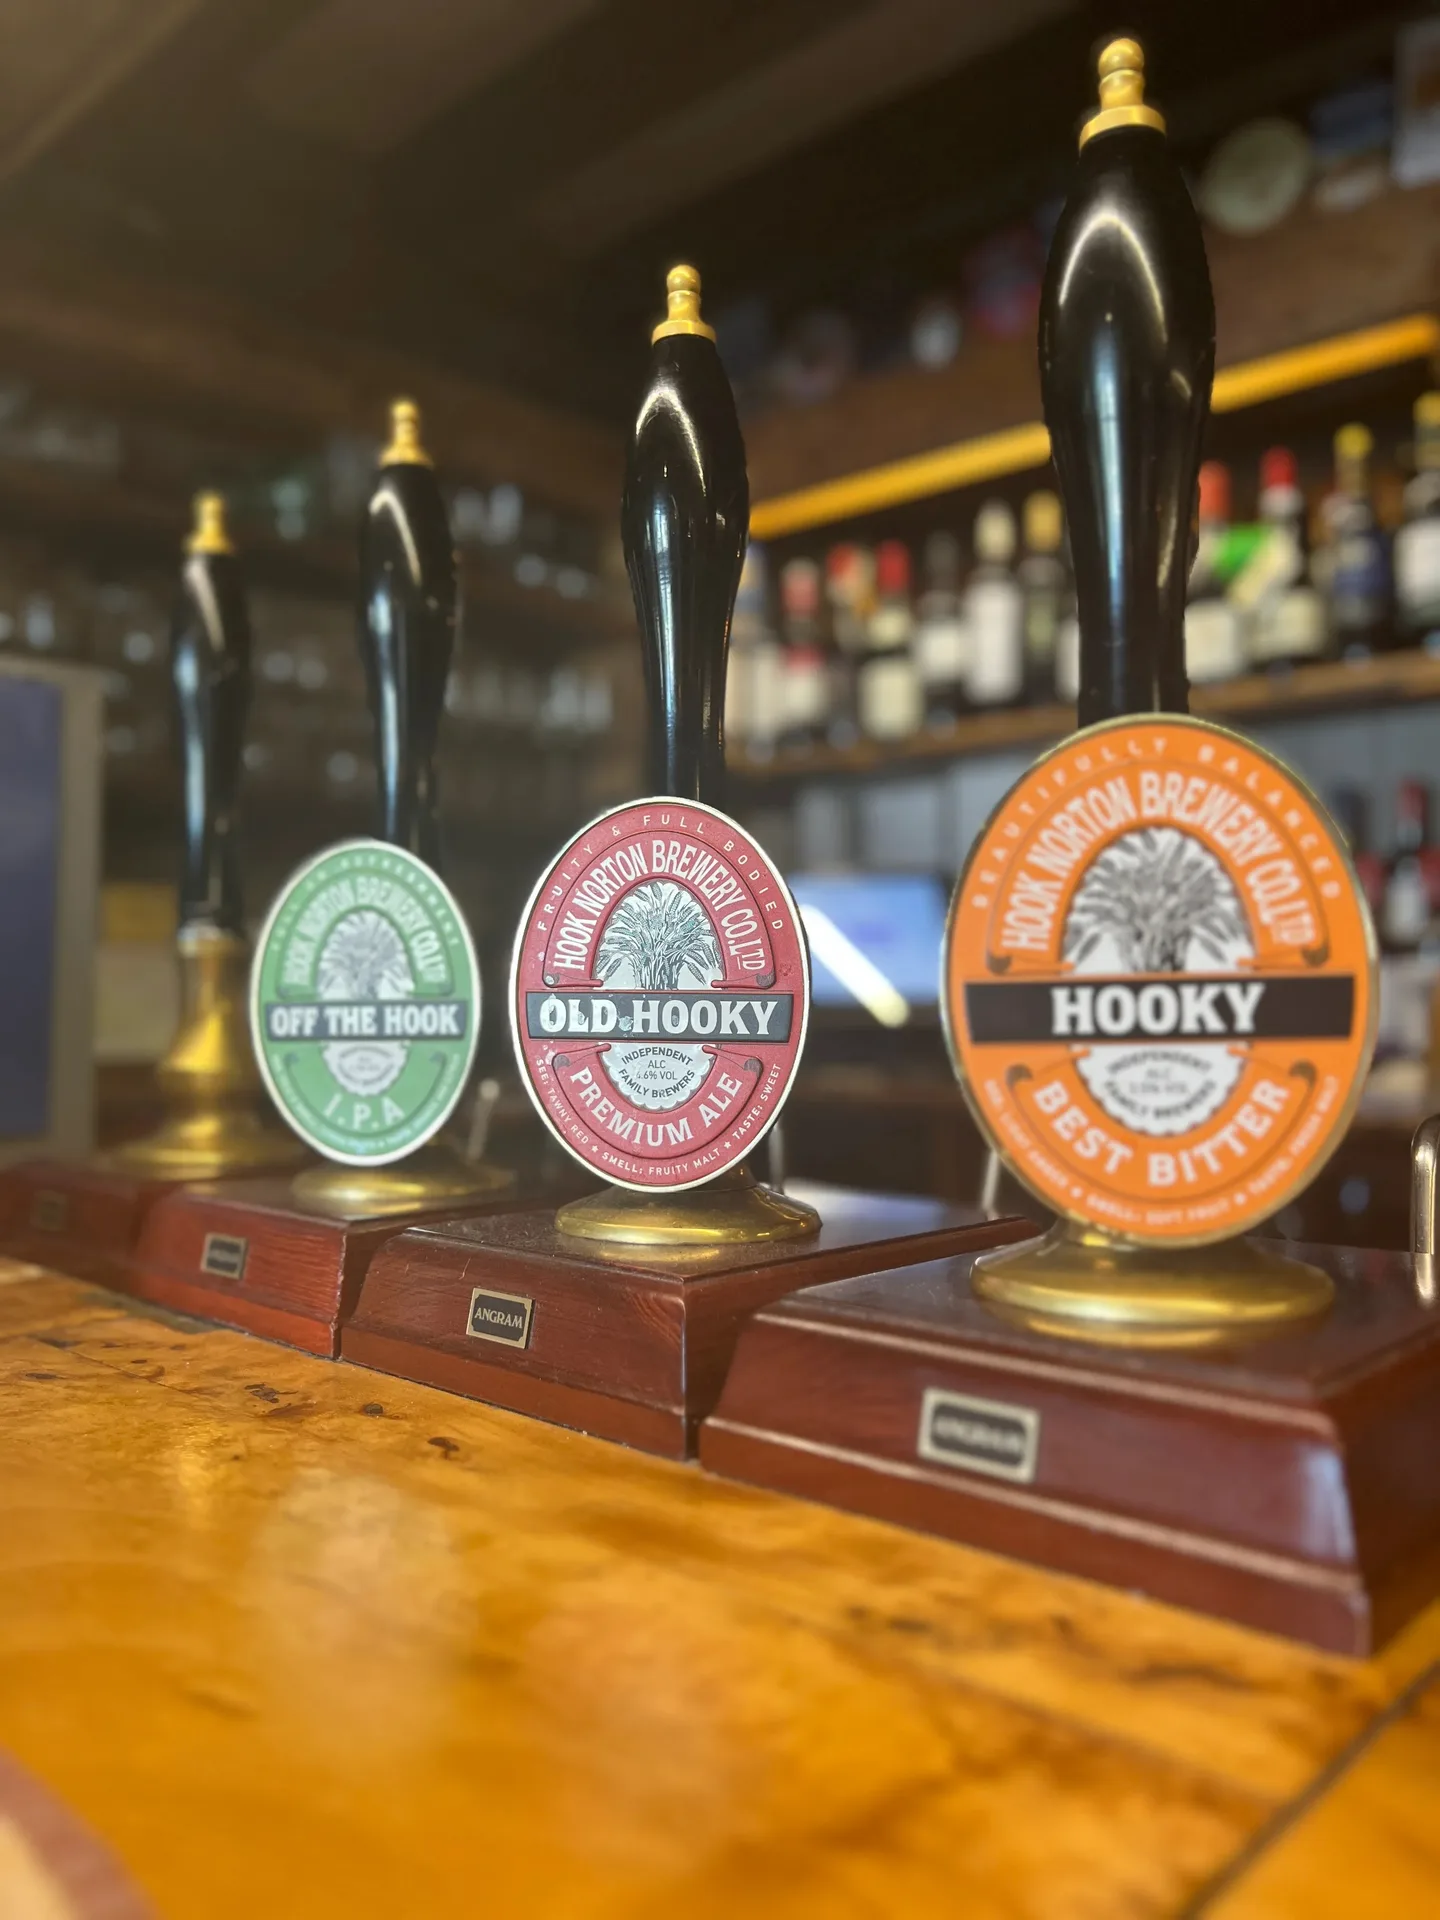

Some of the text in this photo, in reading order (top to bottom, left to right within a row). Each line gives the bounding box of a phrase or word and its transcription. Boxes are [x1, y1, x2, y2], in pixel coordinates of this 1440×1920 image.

[1027, 775, 1137, 880] NORTON
[1139, 770, 1282, 867] BREWERY
[1197, 743, 1341, 899] BALANCED
[537, 814, 783, 931] FRUITY & FULL BODIED
[574, 843, 648, 909] NORTON
[652, 840, 746, 911] BREWERY
[553, 911, 596, 970] HOOK
[1002, 871, 1060, 951] HOOK
[270, 1004, 460, 1037] OFF THE HOOK
[540, 998, 778, 1034] OLD HOOKY
[1050, 982, 1266, 1036] HOOKY
[618, 1069, 695, 1098] FAMILY BREWERS
[621, 1047, 693, 1066] INDEPENDENT
[648, 1060, 666, 1068] ALC
[660, 1071, 677, 1080] VOL
[547, 1088, 572, 1123] TAWNY
[571, 1124, 589, 1144] RED
[648, 1163, 689, 1176] FRUITY
[693, 1148, 721, 1169] MALT
[760, 1063, 781, 1102] SWEET
[570, 1066, 743, 1147] PREMIUM ALE
[1032, 1079, 1134, 1175] BEST
[1147, 1078, 1290, 1188] BITTER
[474, 1307, 523, 1329] ANGRAM
